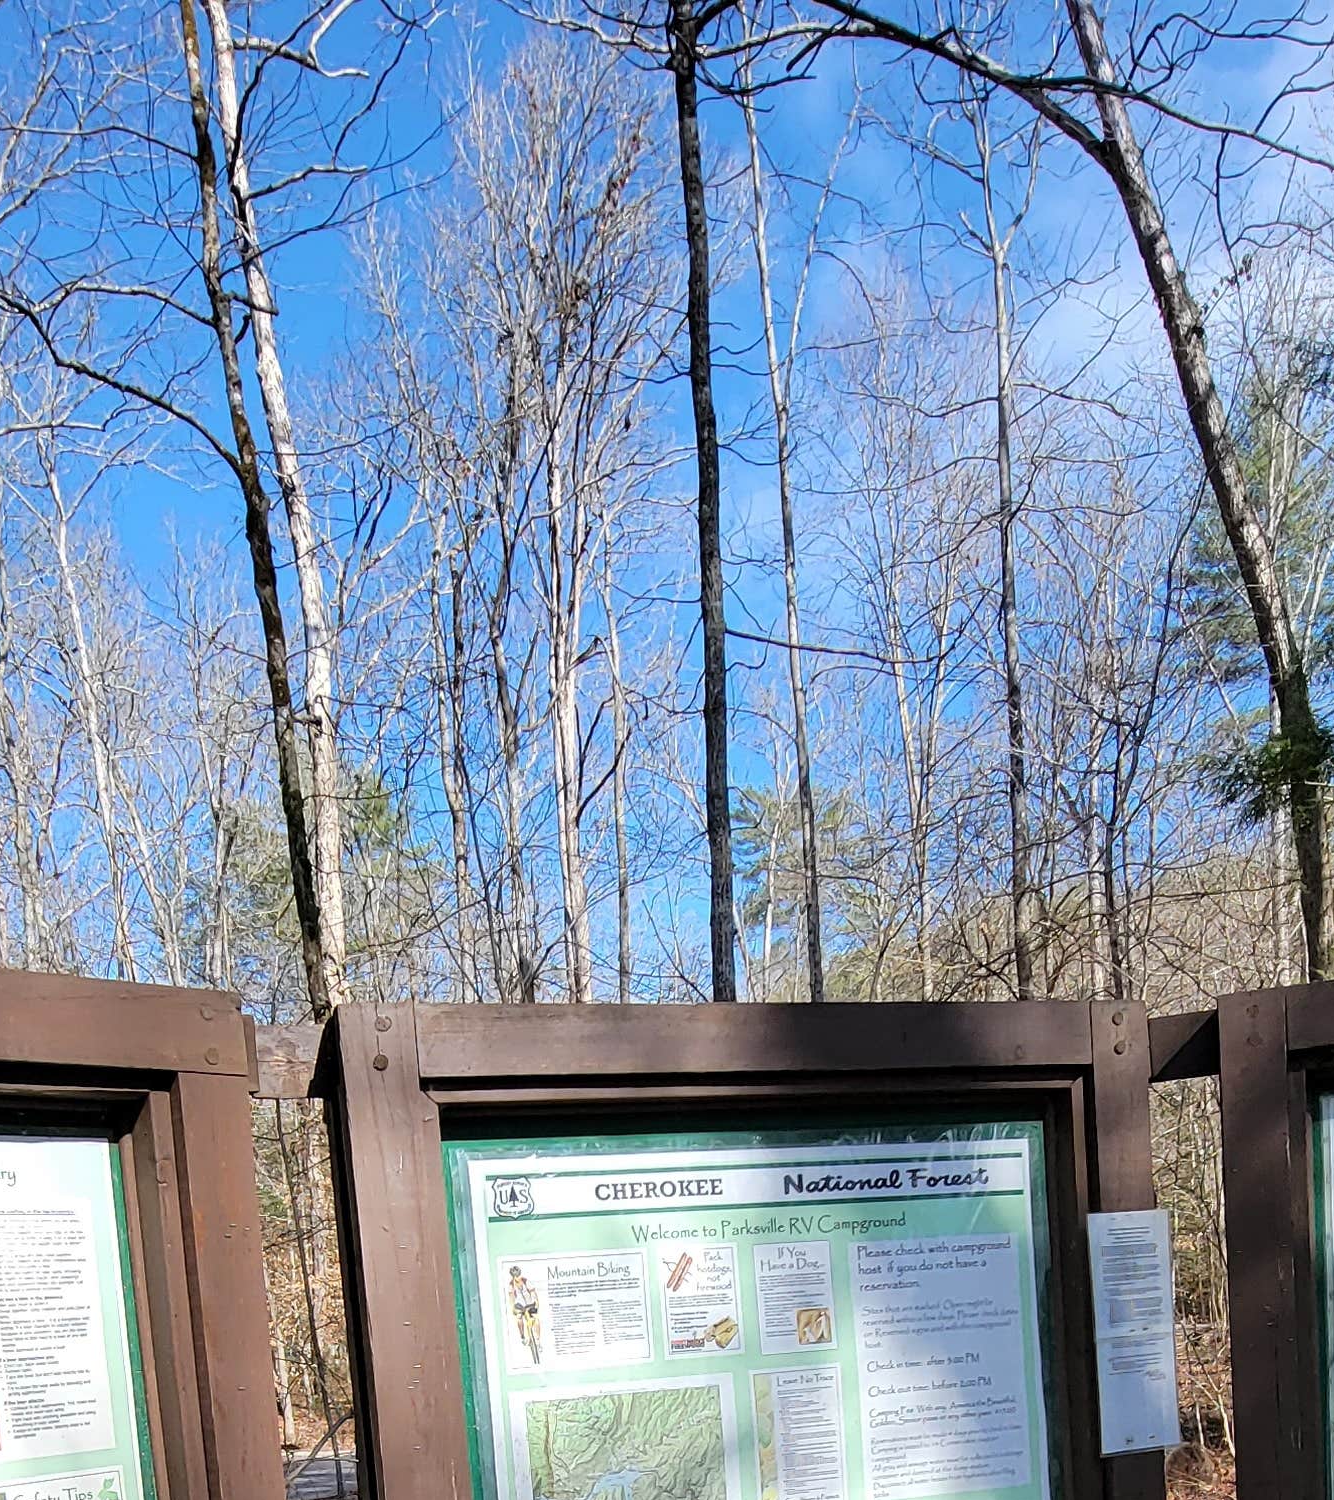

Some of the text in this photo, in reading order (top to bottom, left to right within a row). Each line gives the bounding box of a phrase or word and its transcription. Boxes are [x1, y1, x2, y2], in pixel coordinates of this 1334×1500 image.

[594, 1167, 989, 1201] CHEROKEE National Forest
[631, 1211, 906, 1244] Welcome to Parksville RV Campground
[778, 1246, 806, 1259] If You
[857, 1245, 893, 1260] Please
[895, 1242, 924, 1257] check
[951, 1235, 1011, 1257] campground
[547, 1261, 631, 1281] Mountain Biking
[760, 1260, 786, 1272] Have
[858, 1262, 882, 1275] host
[897, 1263, 917, 1277] you
[919, 1259, 933, 1271] do
[935, 1258, 953, 1269] not
[956, 1256, 979, 1268] have
[867, 1359, 895, 1373] Check
